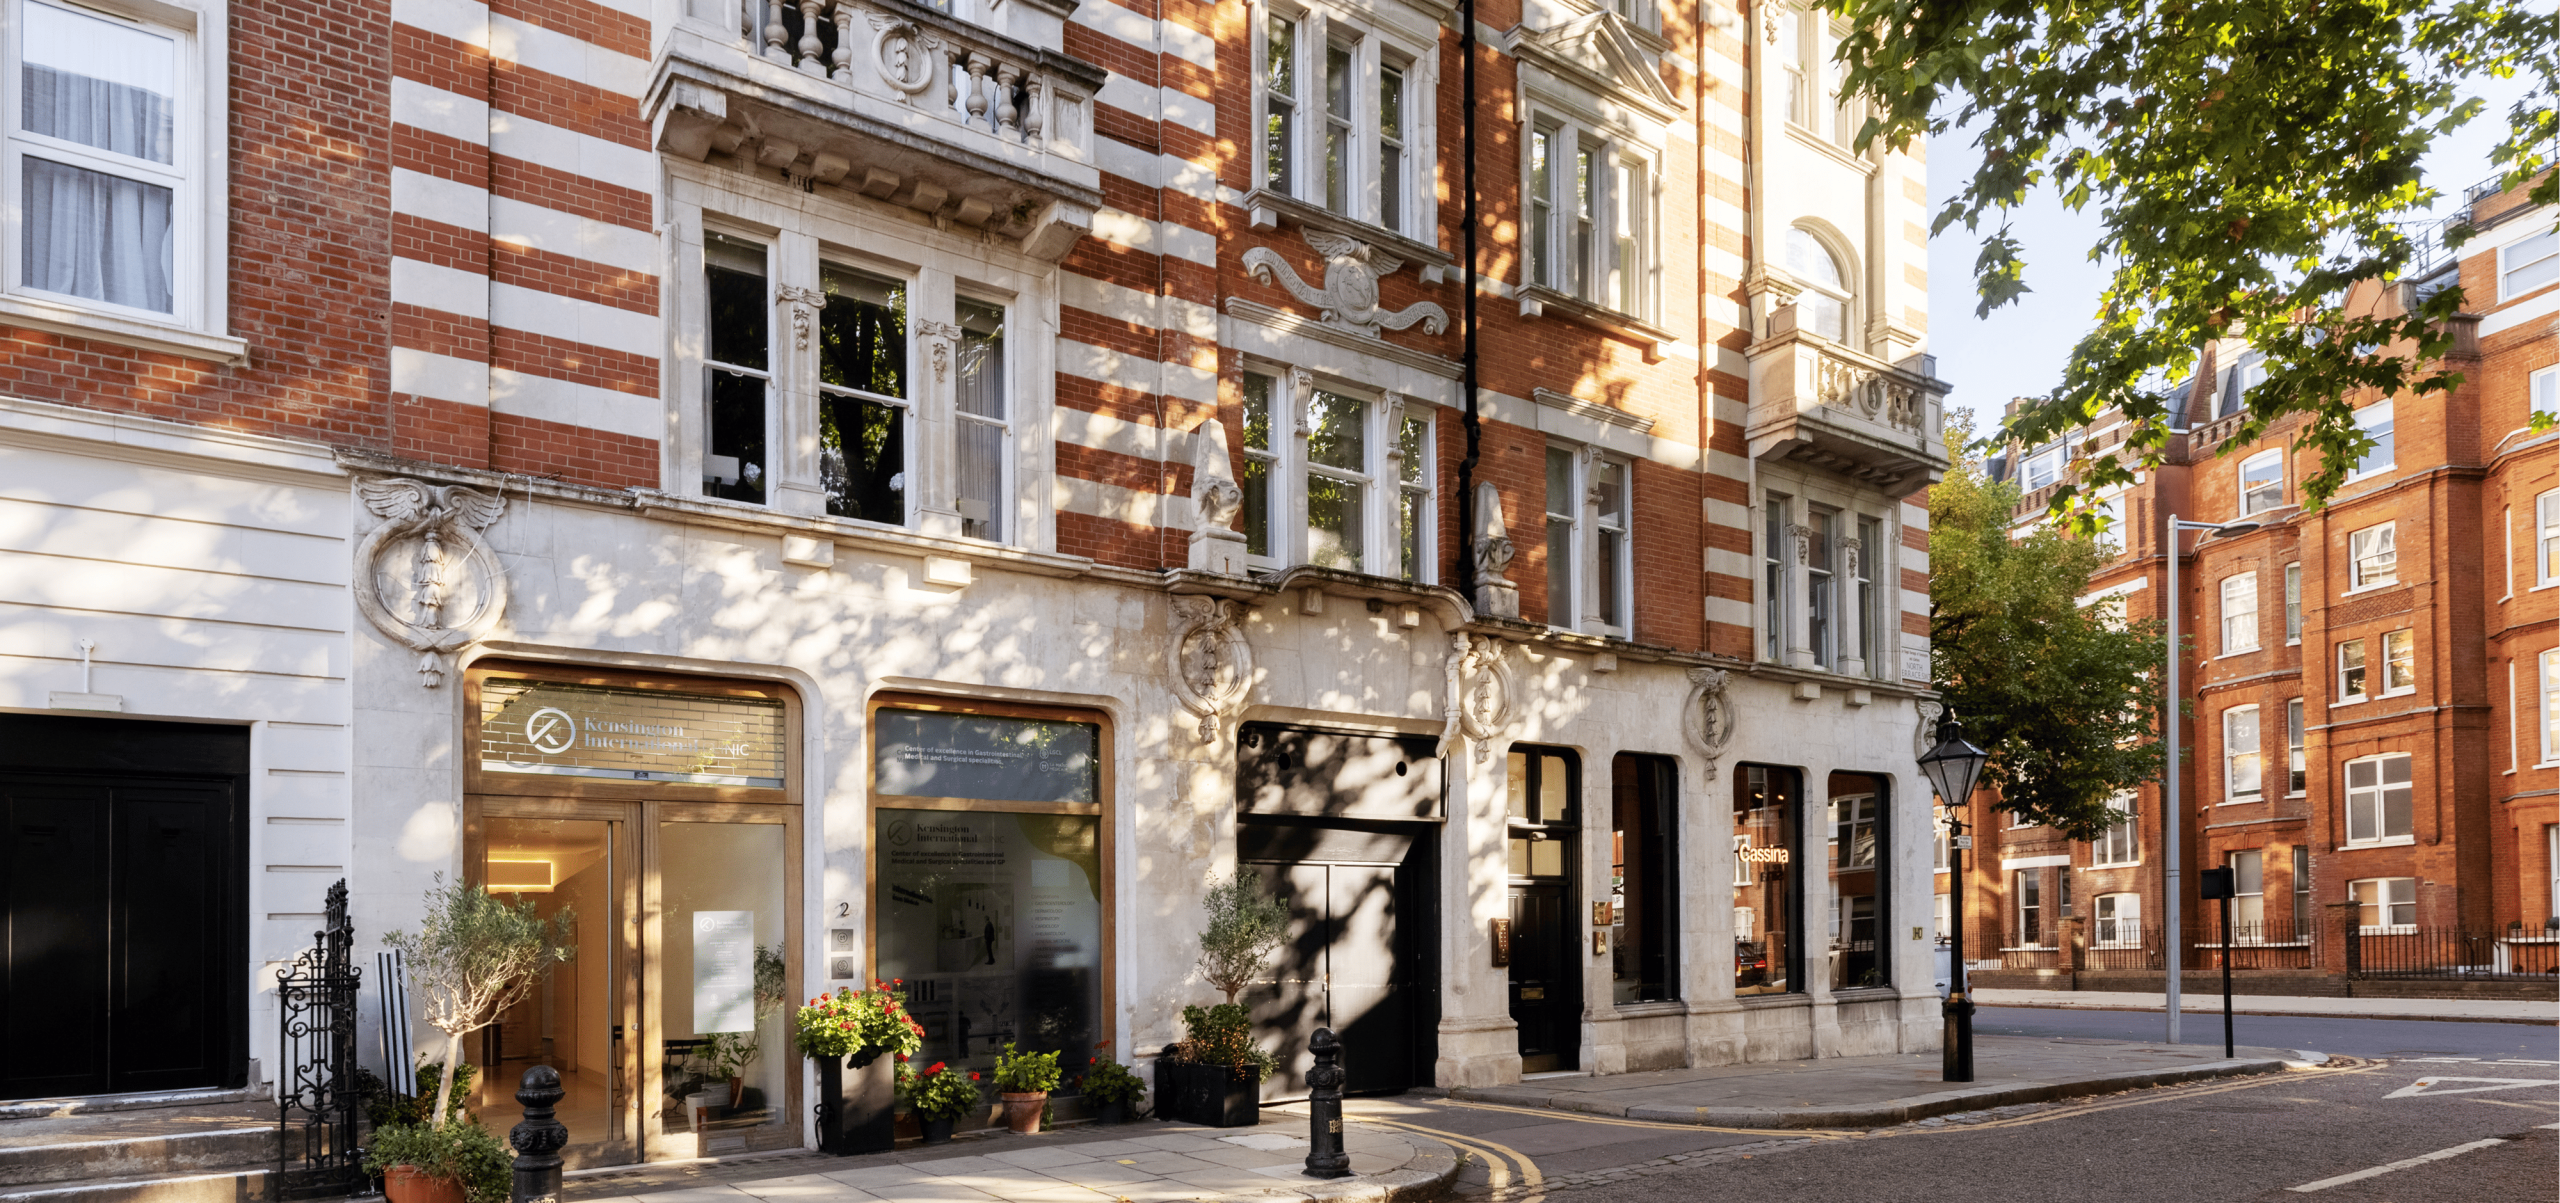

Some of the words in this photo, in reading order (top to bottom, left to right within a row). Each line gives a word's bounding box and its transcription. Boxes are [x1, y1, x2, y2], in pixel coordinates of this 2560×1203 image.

[1393, 307, 1421, 327] RUBBER
[1906, 662, 1923, 671] NORTH
[1901, 669, 1921, 679] ERRACE
[585, 717, 684, 737] Kensington
[585, 733, 698, 753] International
[935, 747, 967, 755] excellence
[943, 755, 967, 763] Surgical
[917, 824, 969, 835] Kensington
[917, 833, 977, 843] International
[1739, 843, 1789, 863] Cassina
[839, 901, 850, 917] 2
